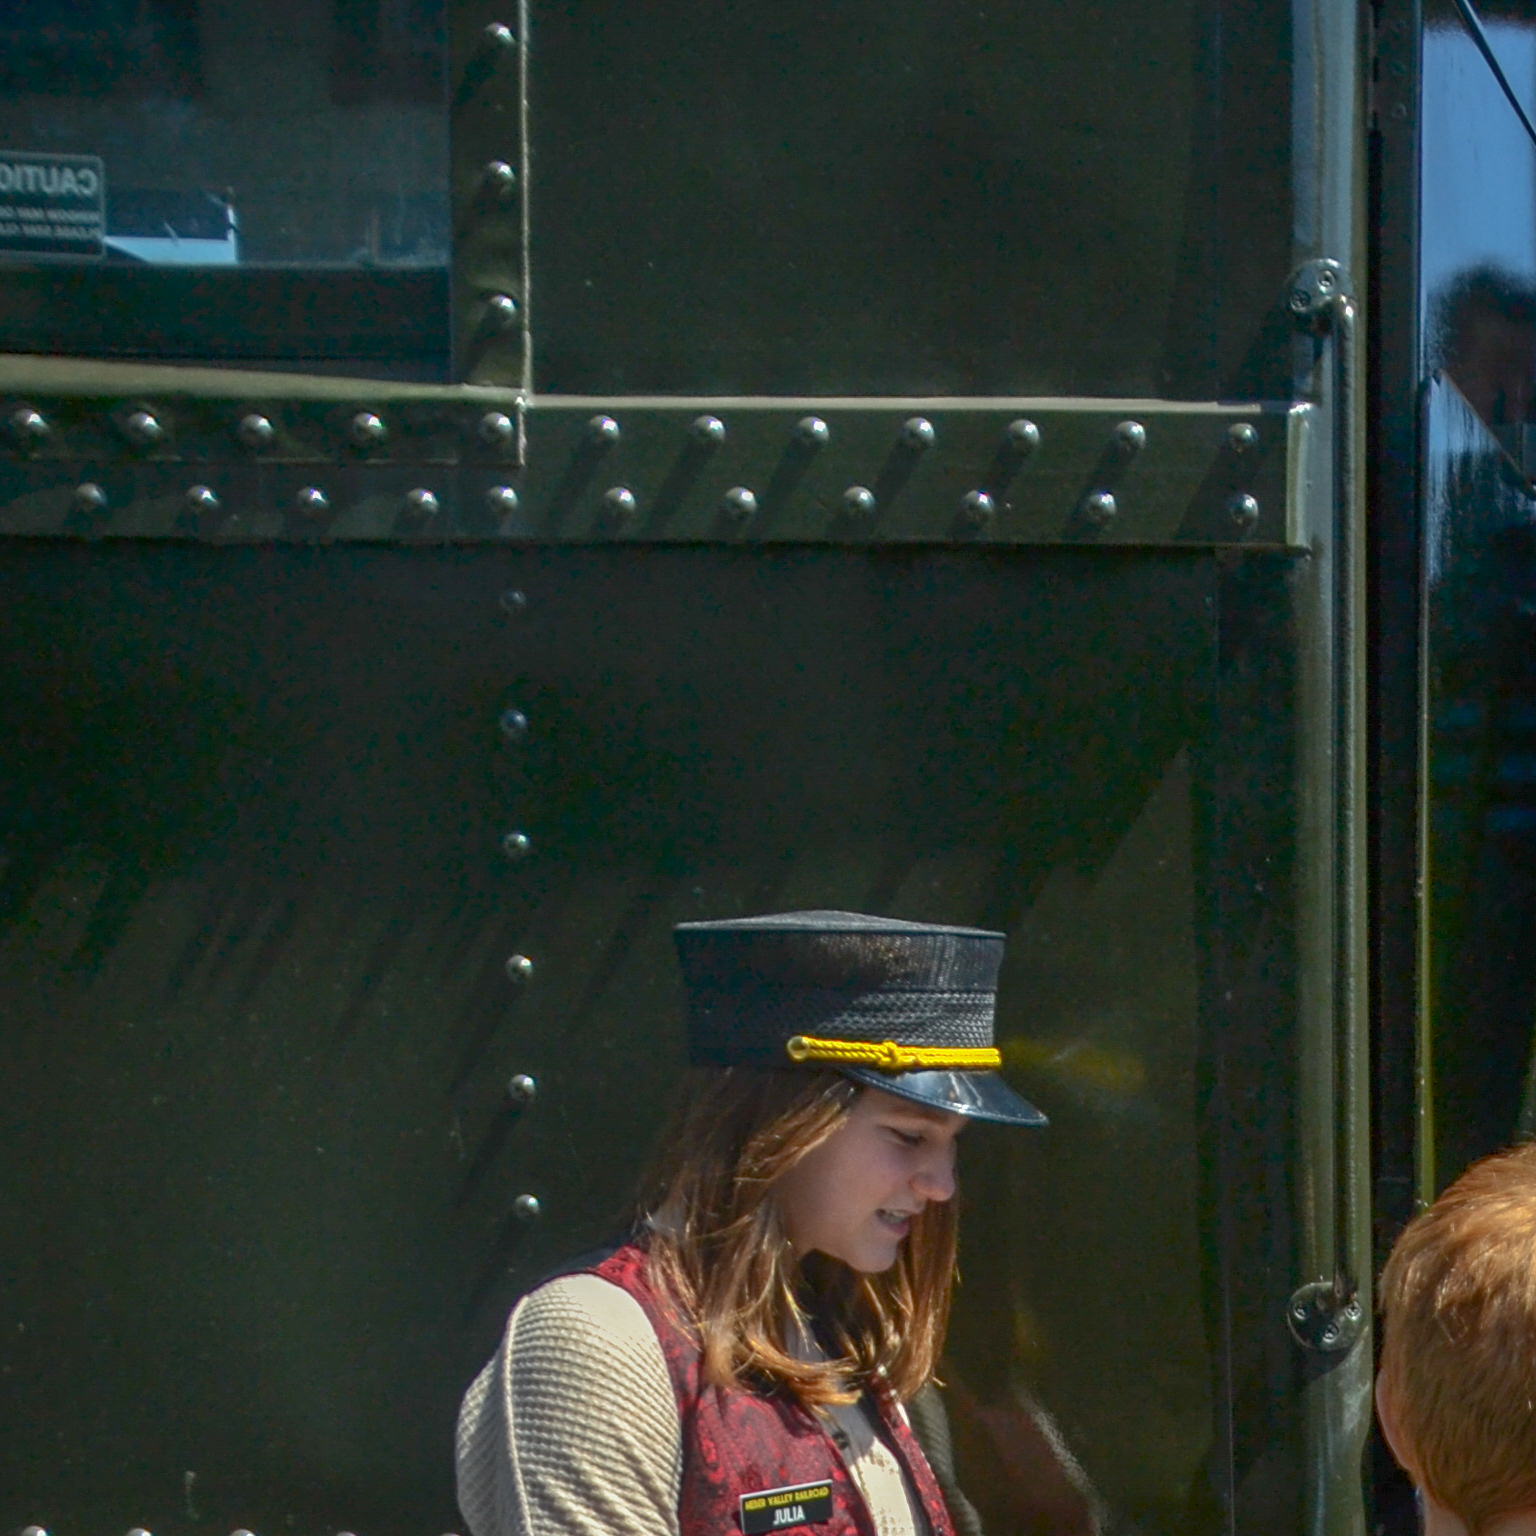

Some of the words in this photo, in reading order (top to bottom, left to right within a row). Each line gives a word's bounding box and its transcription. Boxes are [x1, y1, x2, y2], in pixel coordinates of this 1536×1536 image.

[768, 1493, 793, 1506] VALLEY
[795, 1486, 829, 1501] RAILROAD
[773, 1504, 806, 1526] JULIA
